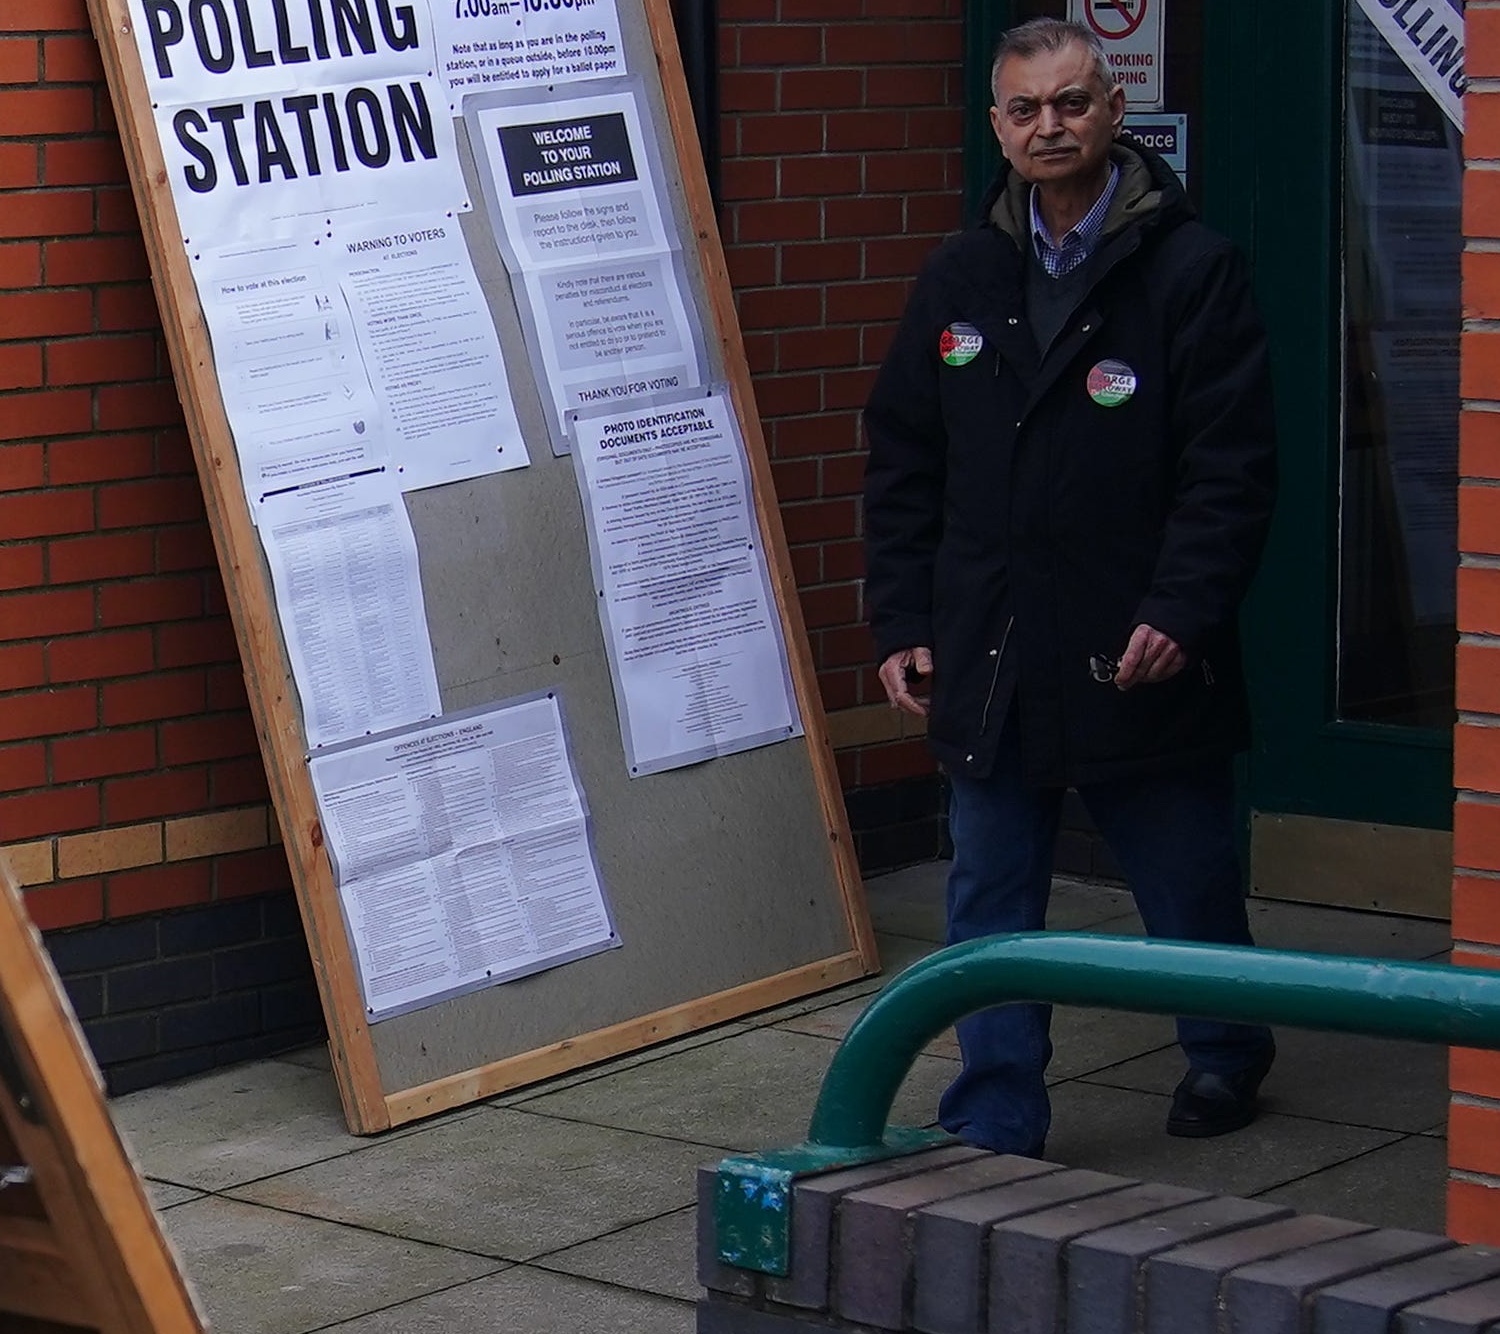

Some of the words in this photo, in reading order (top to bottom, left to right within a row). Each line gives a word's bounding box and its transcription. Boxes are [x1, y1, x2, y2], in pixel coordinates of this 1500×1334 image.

[452, 44, 471, 54] Note
[473, 42, 487, 52] that
[499, 40, 513, 51] long
[527, 39, 538, 49] you
[541, 37, 553, 45] are
[555, 34, 563, 43] in
[565, 32, 578, 42] the
[581, 30, 605, 43] polling
[447, 59, 477, 71] station,
[479, 59, 485, 67] or
[487, 57, 494, 66] in
[502, 56, 523, 67] queue
[526, 51, 556, 62] outside,
[557, 49, 581, 58] before
[584, 45, 615, 56] 10.00pm
[1106, 54, 1152, 66] MOKING
[449, 78, 464, 89] you
[467, 74, 480, 83] will
[482, 74, 490, 82] be
[492, 70, 520, 81] entitled
[521, 69, 529, 78] to
[532, 67, 550, 78] apply
[552, 66, 562, 74] for
[571, 62, 593, 72] ballot
[594, 61, 616, 72] paper
[1112, 72, 1147, 84] APING
[173, 82, 438, 193] STATION
[533, 126, 592, 145] WELCOME
[542, 150, 557, 164] TO
[560, 146, 592, 161] YOUR
[523, 168, 572, 186] POLLING
[576, 162, 621, 179] STATION
[534, 213, 559, 223] Please
[560, 210, 582, 219] follow
[616, 202, 629, 211] and
[347, 237, 392, 253] WARNING
[394, 234, 407, 245] TO
[408, 228, 446, 243] VOTERS
[281, 276, 306, 284] election
[579, 387, 610, 402] THANK
[611, 384, 629, 396] YOU
[629, 382, 647, 393] FOR
[649, 376, 678, 390] VOTING
[604, 421, 634, 434] PHOTO
[637, 408, 705, 428] IDENTIFICATION
[599, 429, 658, 449] DOCUMENTS
[661, 420, 714, 438] ACCEPTABLE
